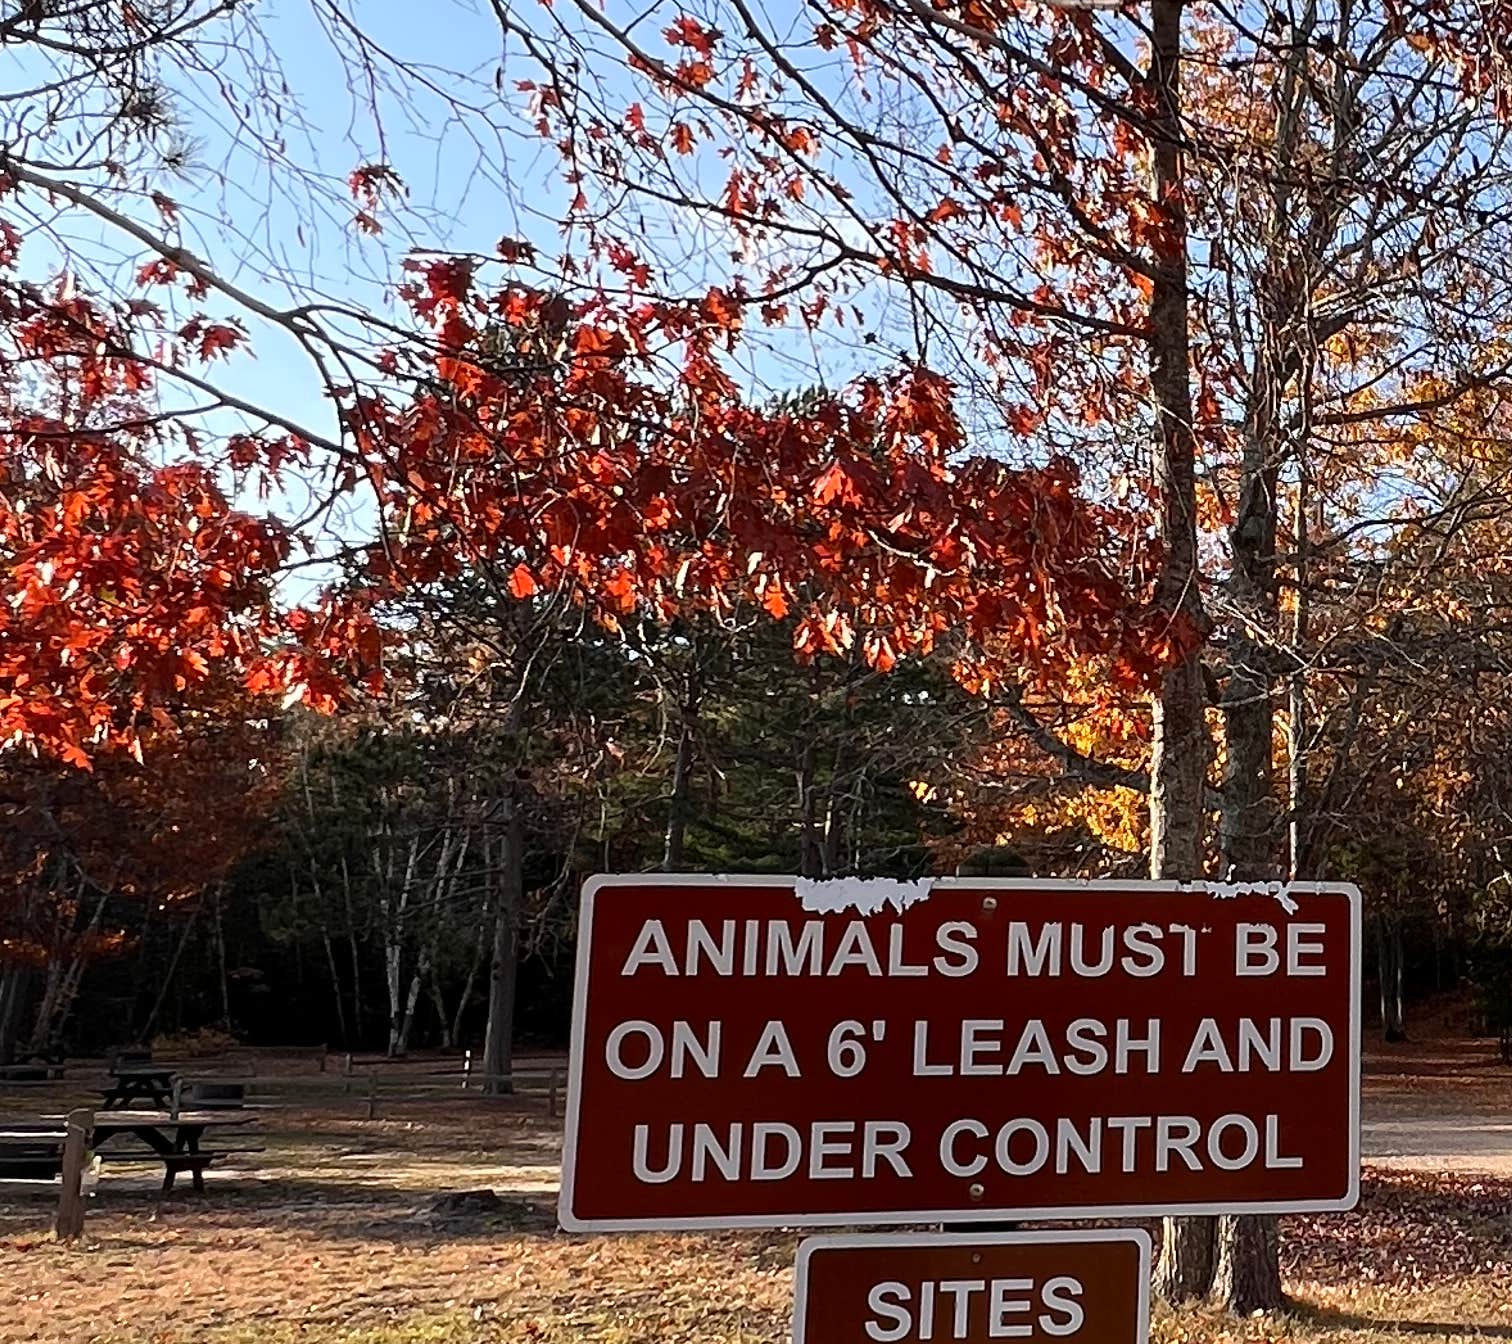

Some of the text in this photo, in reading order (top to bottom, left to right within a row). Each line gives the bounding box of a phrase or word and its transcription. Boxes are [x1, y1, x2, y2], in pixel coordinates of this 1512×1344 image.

[621, 918, 1326, 976] ANIMALS MUST BE
[606, 1018, 1333, 1079] ON A 6' LEASH AND
[633, 1114, 1303, 1183] UNDER CONTROL
[865, 1277, 1084, 1341] SITES
